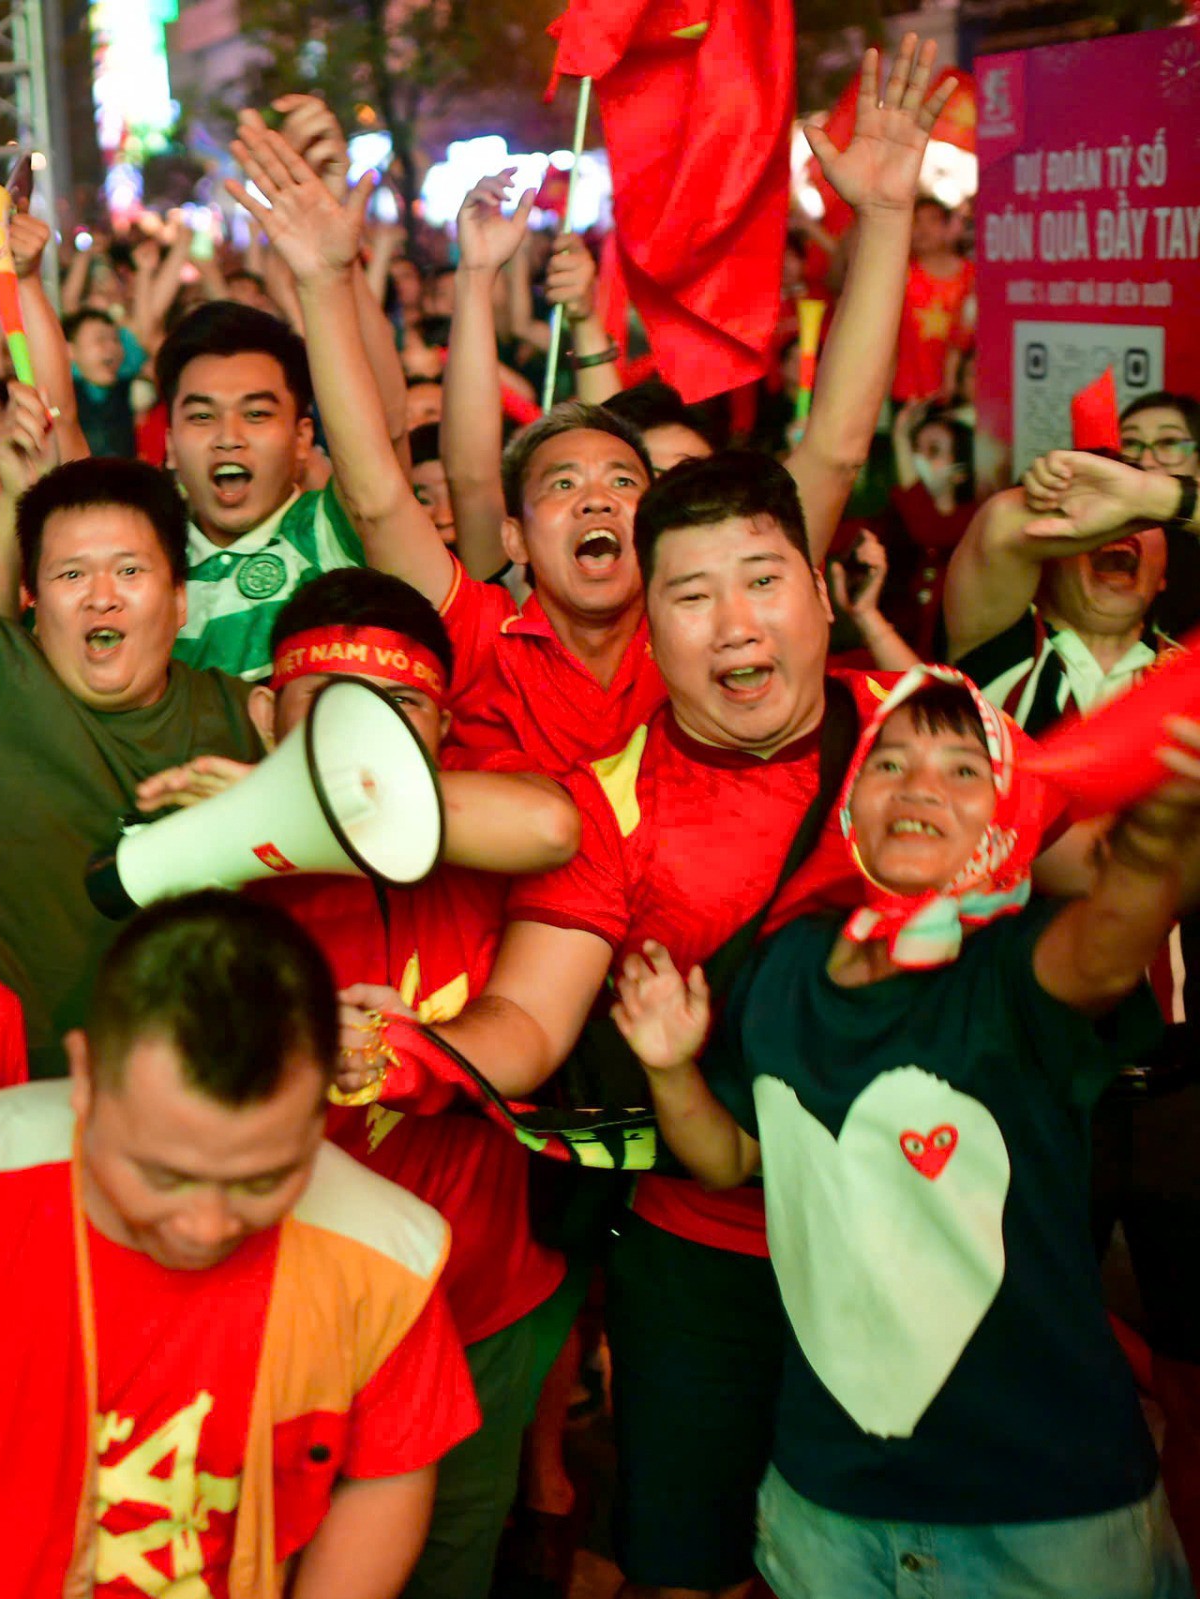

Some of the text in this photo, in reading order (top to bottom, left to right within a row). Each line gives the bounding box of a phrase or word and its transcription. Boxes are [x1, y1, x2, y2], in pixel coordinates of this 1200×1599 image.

[1137, 128, 1167, 187] SỐ
[1040, 200, 1090, 262] QUÀ
[1096, 190, 1148, 261] ĐẦY
[1153, 206, 1200, 260] TAY
[310, 642, 367, 662] NAM
[374, 647, 409, 671] VÔ
